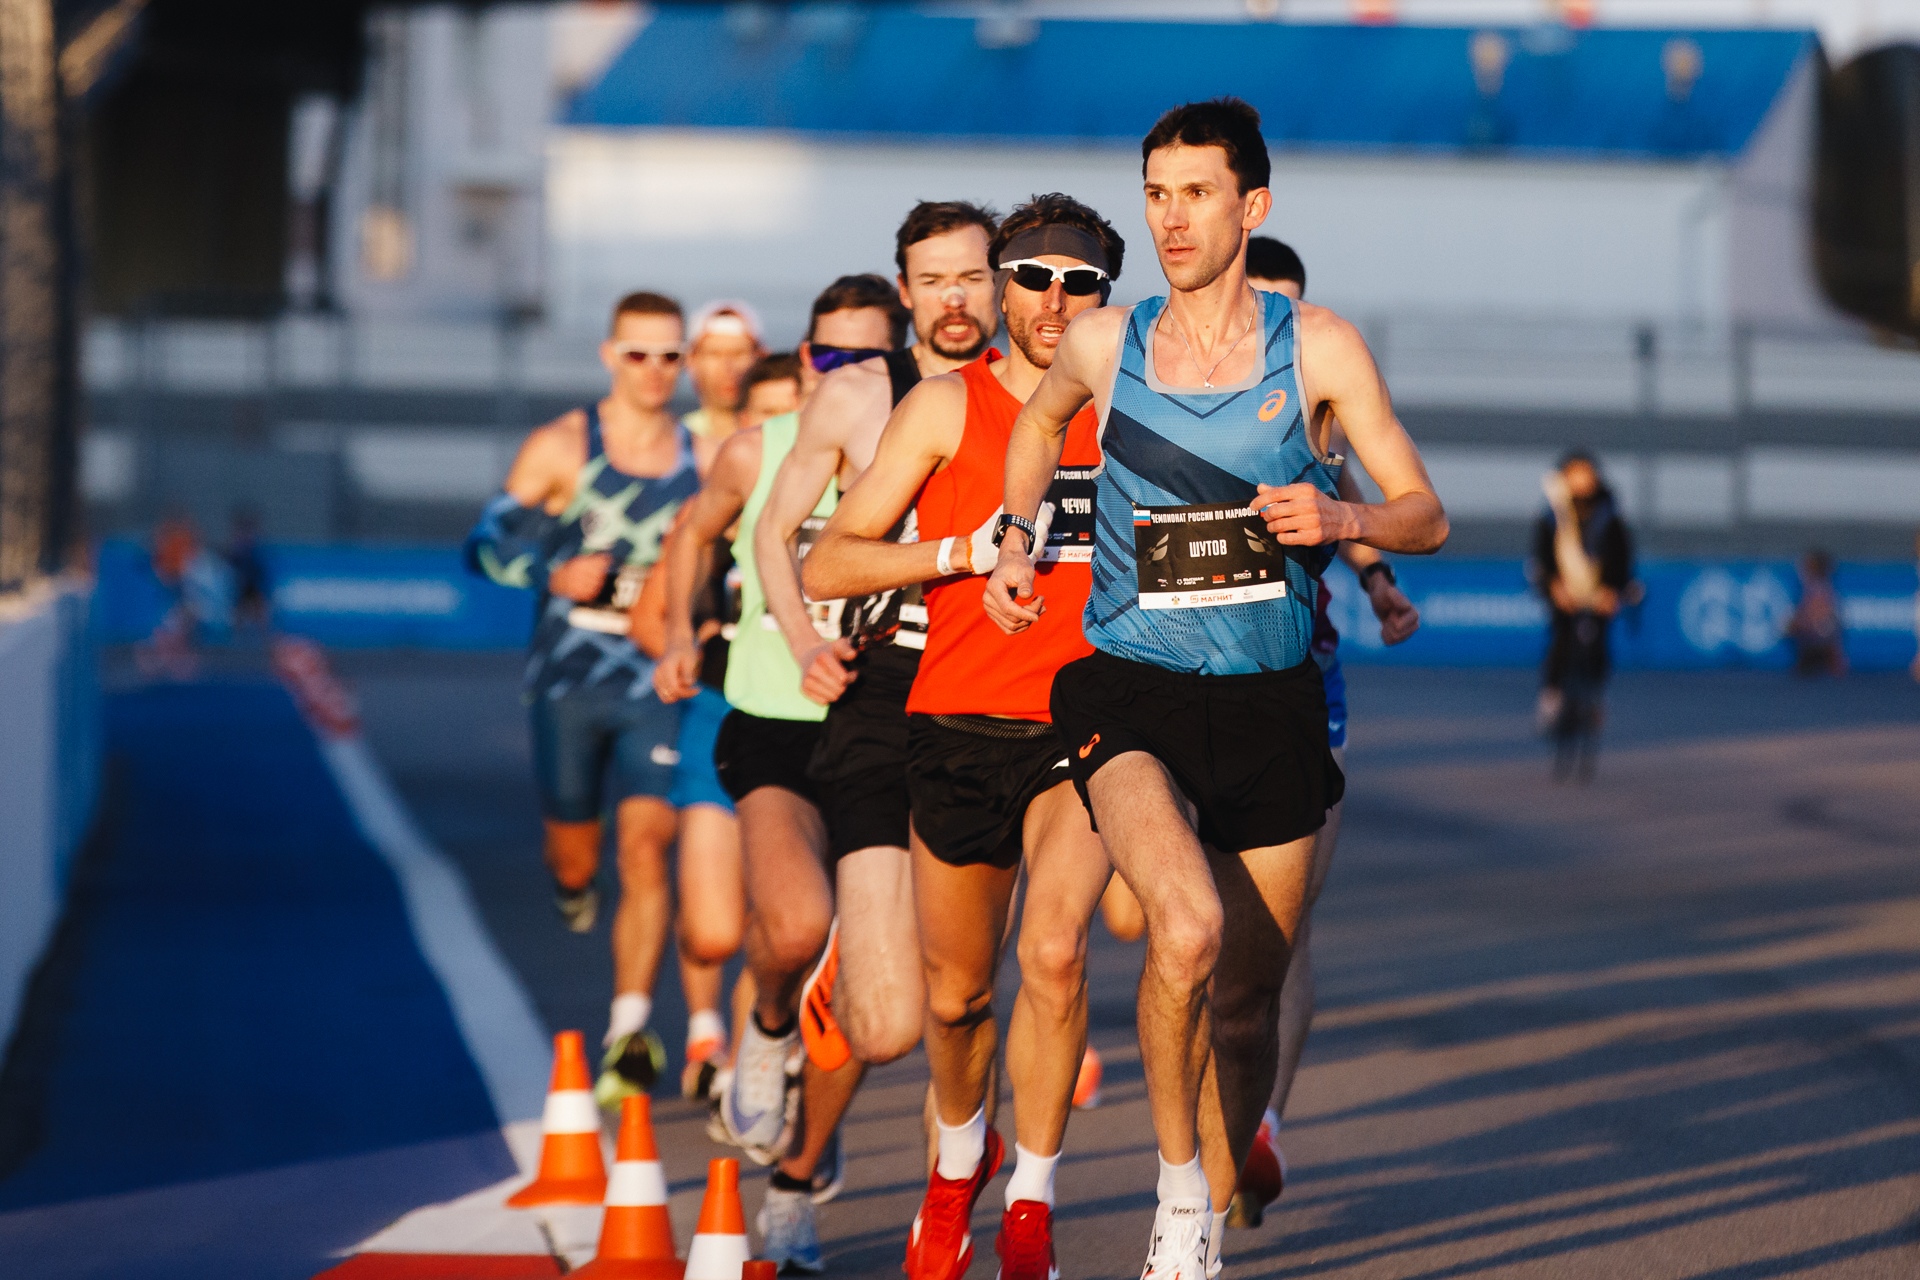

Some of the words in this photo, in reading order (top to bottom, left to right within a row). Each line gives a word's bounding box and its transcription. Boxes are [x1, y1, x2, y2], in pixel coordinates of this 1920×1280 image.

[1061, 498, 1091, 514] ЧЕЧУН
[1151, 513, 1186, 524] ЧЕМПИОНАТ
[1188, 511, 1214, 522] РОССИИ
[1214, 510, 1223, 520] ПО
[1189, 539, 1228, 558] ШУТОВ
[1201, 594, 1233, 603] МАГНИТ
